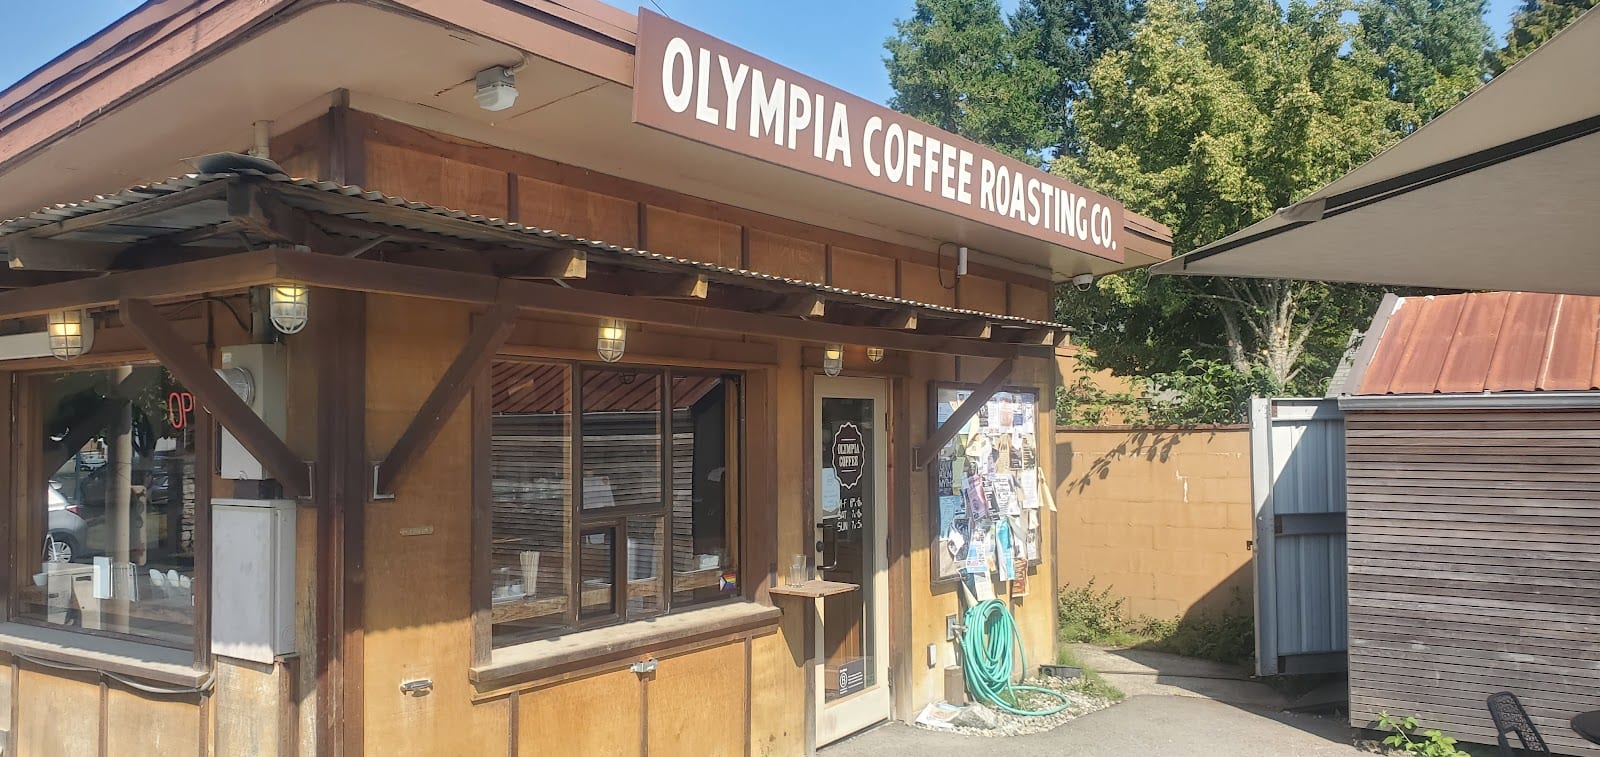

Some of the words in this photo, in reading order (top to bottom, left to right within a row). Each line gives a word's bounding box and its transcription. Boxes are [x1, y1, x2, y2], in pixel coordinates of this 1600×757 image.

[661, 36, 852, 168] OLYMPIA
[862, 115, 973, 206] COFFEE
[979, 157, 1089, 244] ROASTING
[1090, 204, 1118, 251] CO.
[168, 392, 195, 429] OP
[838, 443, 860, 455] OLYMPIA
[838, 455, 859, 468] COFFEE
[837, 521, 848, 531] SUN
